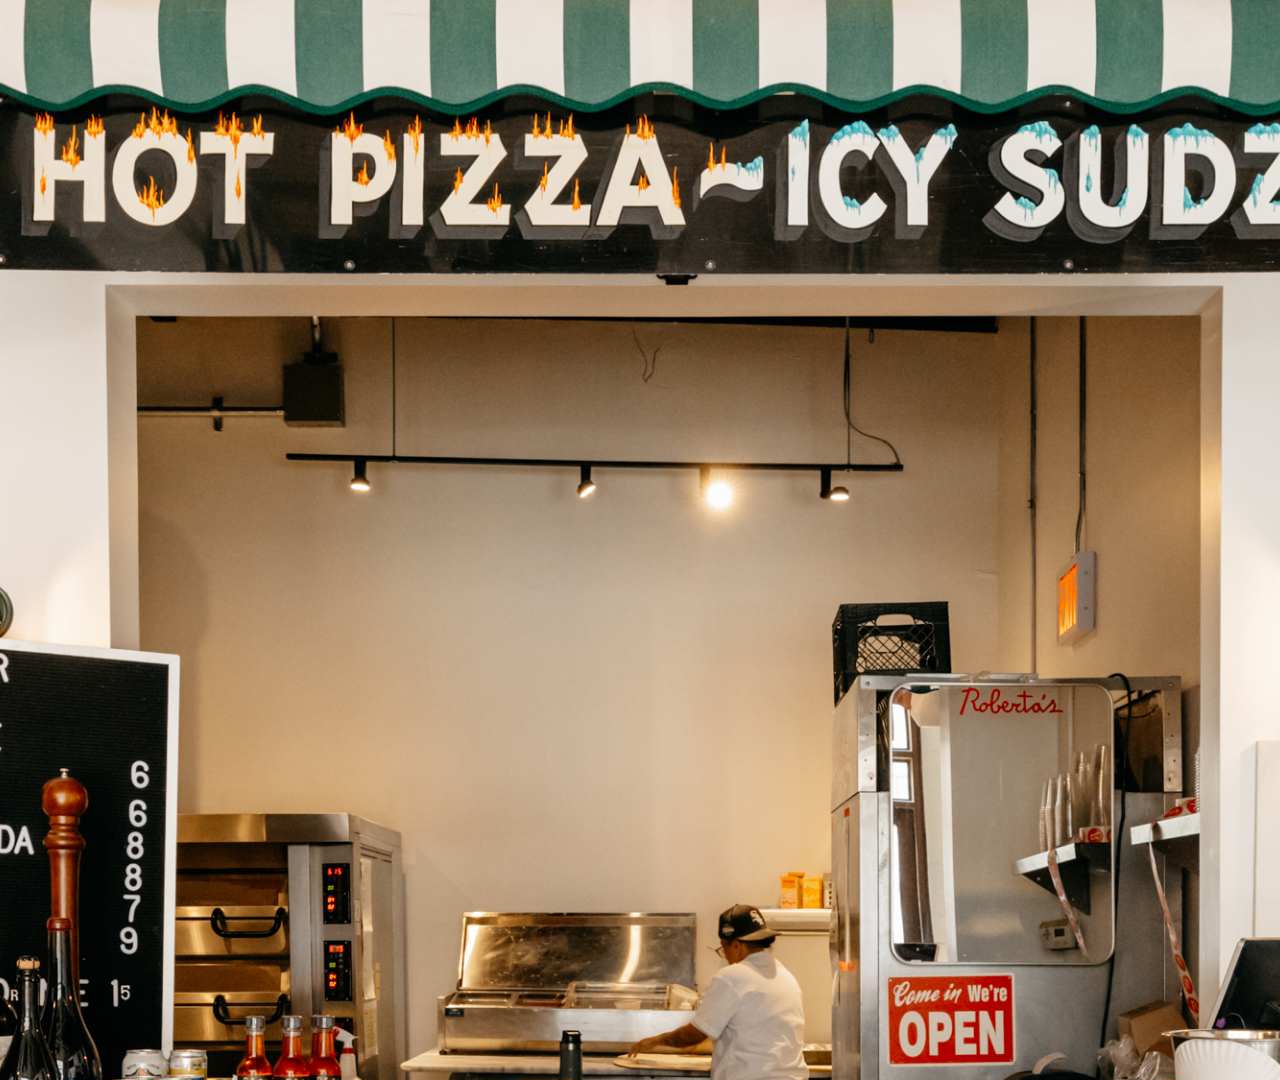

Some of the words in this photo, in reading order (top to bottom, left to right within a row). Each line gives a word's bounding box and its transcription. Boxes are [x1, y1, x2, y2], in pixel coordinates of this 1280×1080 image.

[26, 112, 275, 232] HOT
[326, 112, 687, 232] PIZZA
[782, 118, 958, 232] ICY
[959, 687, 1064, 716] Roberta's
[130, 760, 150, 790] 6
[128, 799, 148, 829] 6
[126, 832, 145, 862] 8
[124, 863, 144, 892] 8
[123, 894, 142, 924] 7
[119, 926, 139, 955] 9
[110, 979, 131, 1007] 15
[893, 979, 944, 1007] Come
[943, 977, 961, 1001] in
[967, 984, 1008, 1003] We're
[898, 1010, 1006, 1057] OPEN
